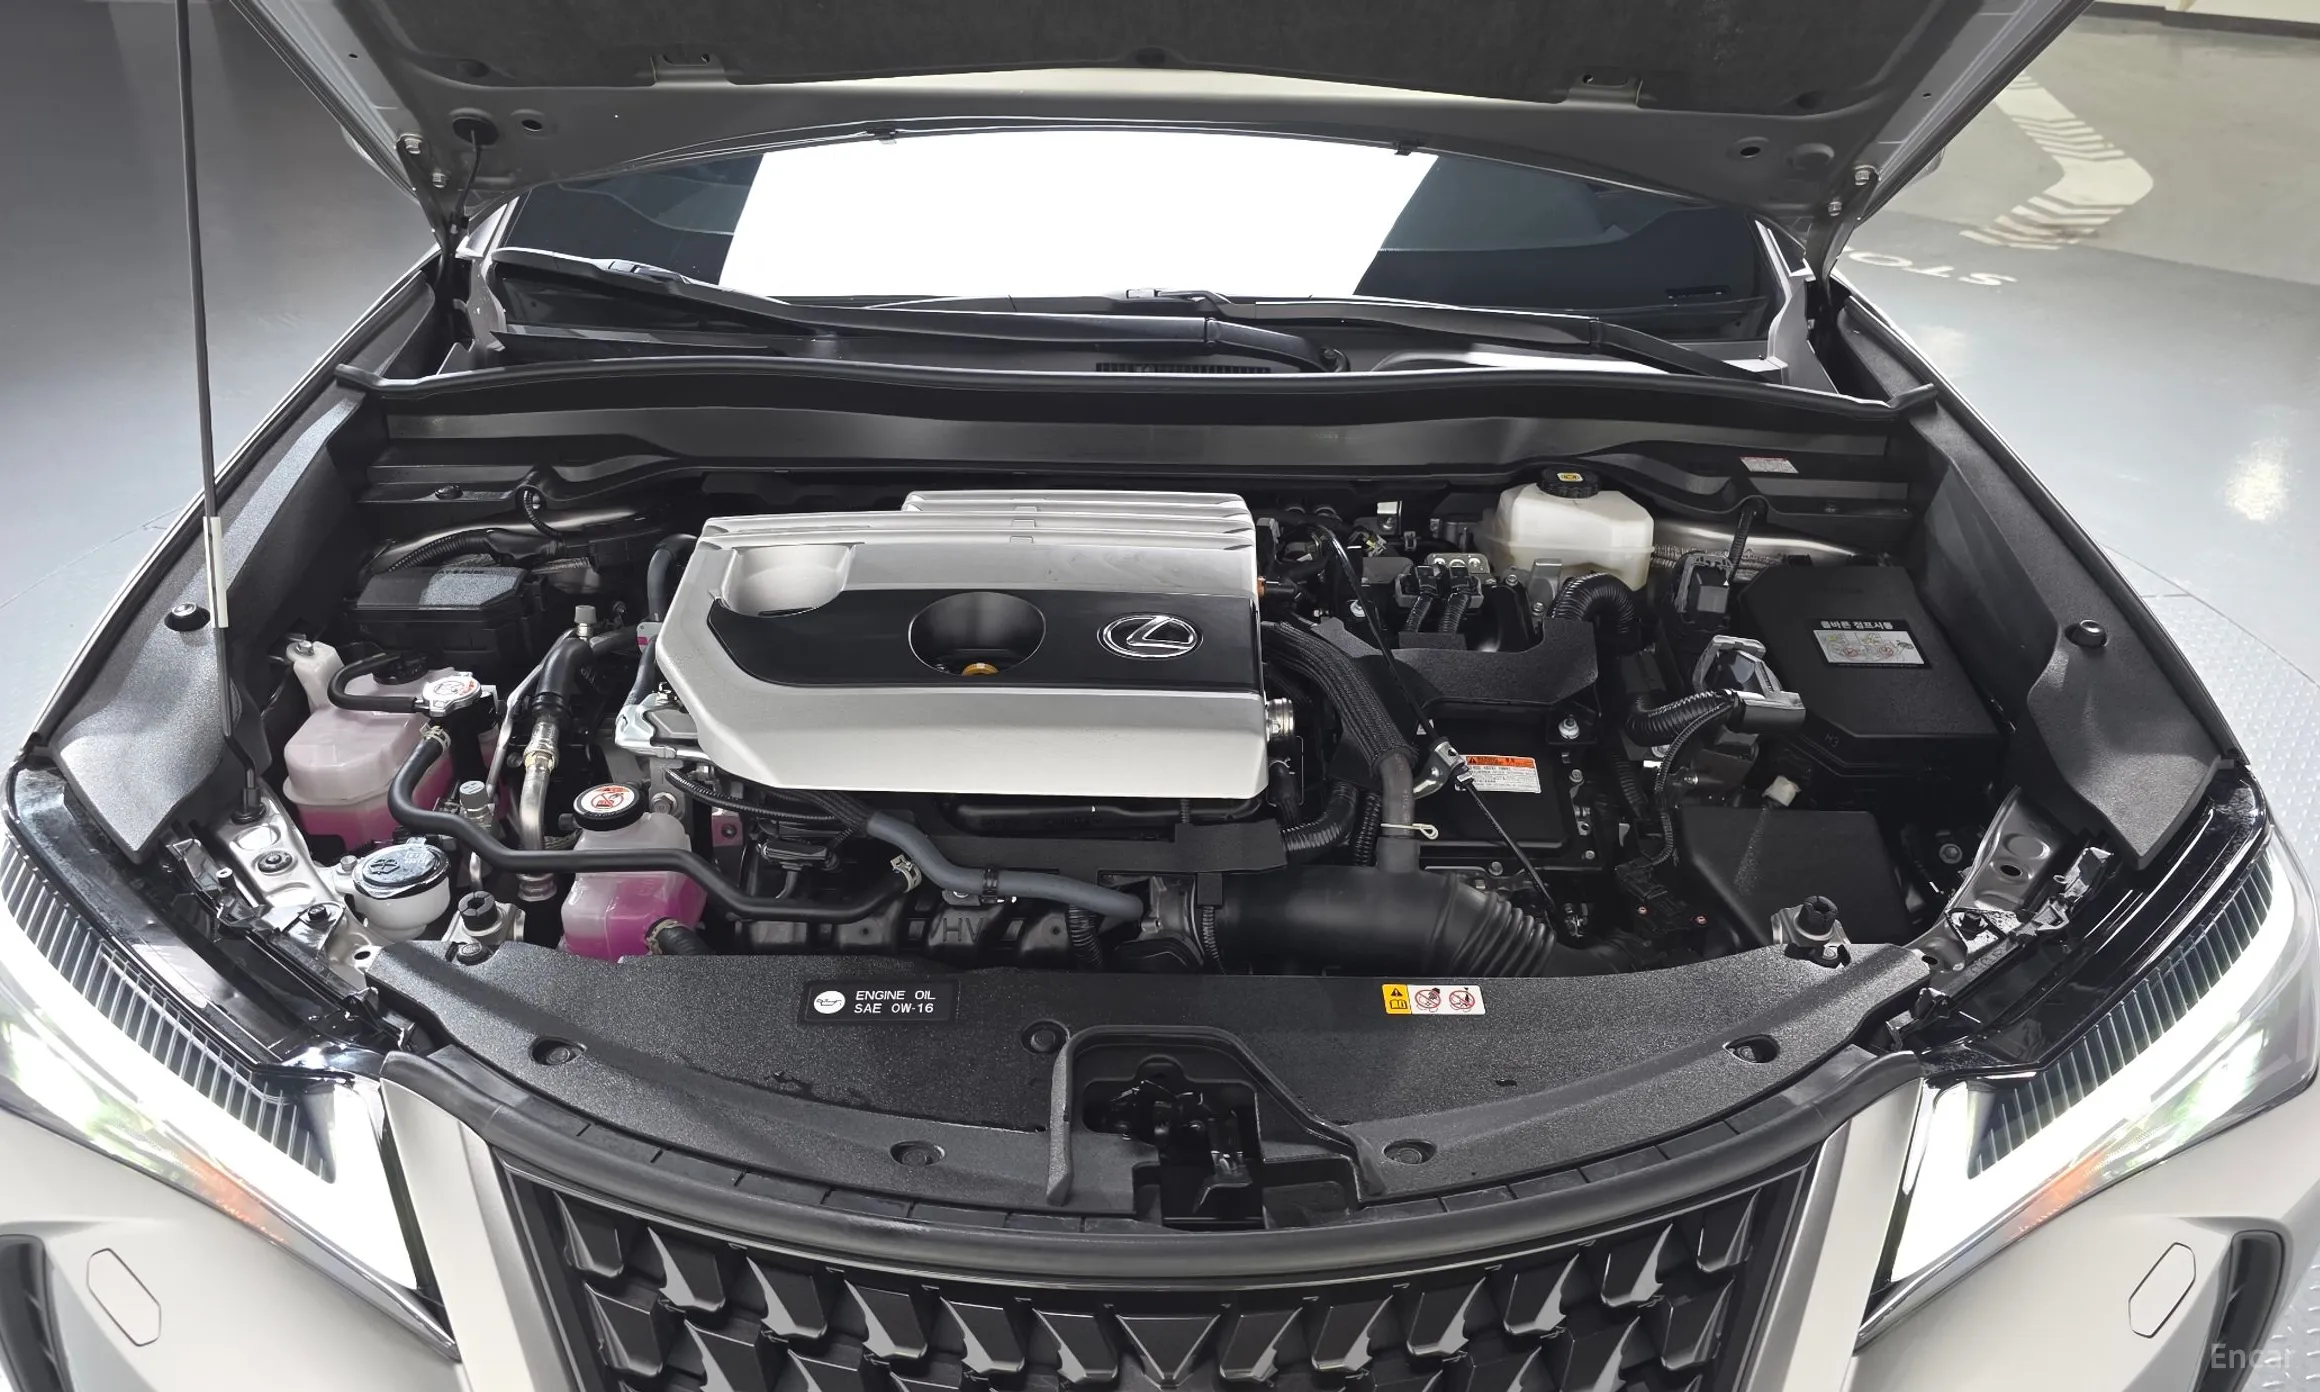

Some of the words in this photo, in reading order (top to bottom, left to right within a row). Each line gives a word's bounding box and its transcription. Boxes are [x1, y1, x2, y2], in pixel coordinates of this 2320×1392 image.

[1842, 245, 2018, 286] STO
[855, 990, 906, 1001] ENGINE
[914, 990, 936, 1001] OIL
[854, 1003, 883, 1014] SAE
[891, 1003, 934, 1014] 0W-16
